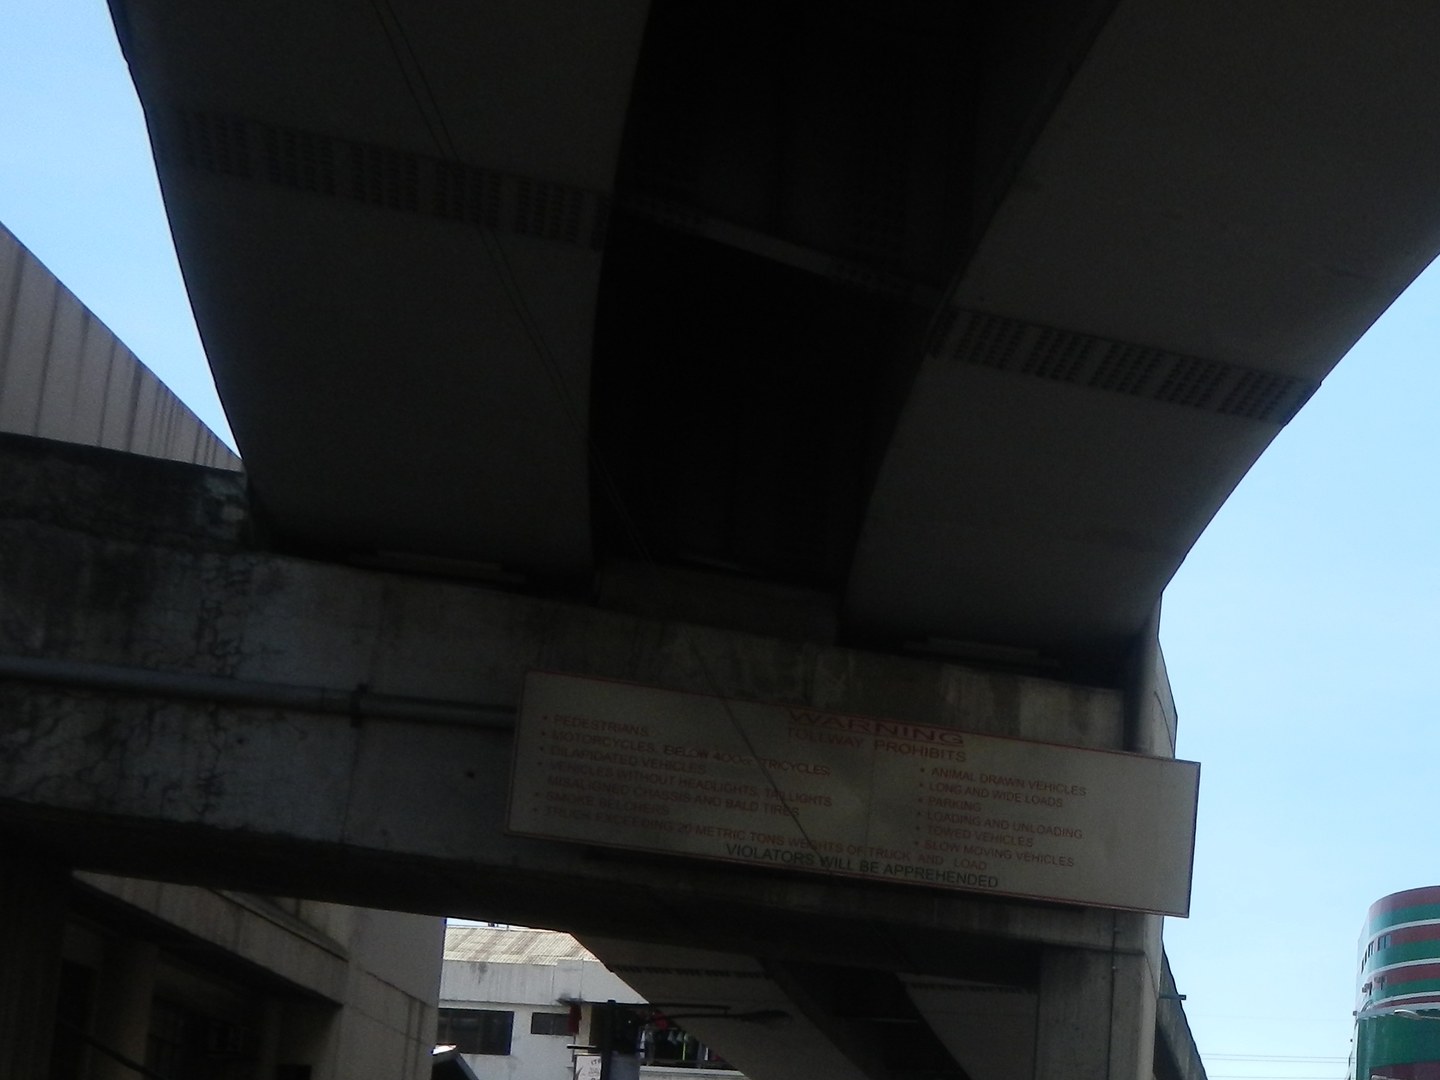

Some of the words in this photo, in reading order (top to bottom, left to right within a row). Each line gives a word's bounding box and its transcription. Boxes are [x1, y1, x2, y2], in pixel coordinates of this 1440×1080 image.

[788, 709, 964, 745] WARNING
[788, 727, 864, 748] TOLLWAY
[874, 739, 966, 762] PROHIBITS
[617, 769, 674, 785] WITHOUT
[641, 760, 705, 774] VEHICLES
[931, 767, 976, 782] ANIMAL
[980, 774, 1024, 788] DRAWN
[1028, 780, 1086, 796] VEHICLES
[694, 795, 721, 808] AND
[726, 799, 758, 813] BALD
[764, 802, 799, 817] TIRES
[928, 796, 982, 812] PARKING
[929, 782, 962, 795] LONG
[964, 787, 989, 799] AND
[991, 790, 1022, 803] WIDE
[1025, 794, 1063, 808] LOADS
[928, 810, 981, 826] LOADING
[984, 818, 1009, 830] AND
[1013, 822, 1083, 839] UNLOADING
[928, 825, 972, 839] TOWED
[975, 832, 1033, 848] VEHICLES
[695, 825, 746, 841] METRIC
[749, 832, 785, 846] TONS
[868, 847, 911, 861] TRUCK
[918, 853, 943, 865] AND
[954, 858, 987, 871] LOAD
[924, 839, 959, 853] SLOW
[963, 845, 1012, 860] MOVING
[1015, 852, 1074, 868] VEHICLES
[726, 843, 814, 865] VIOLATORS
[820, 856, 855, 871] WILL
[860, 860, 879, 873] BE
[883, 864, 998, 888] APPREHENDED
